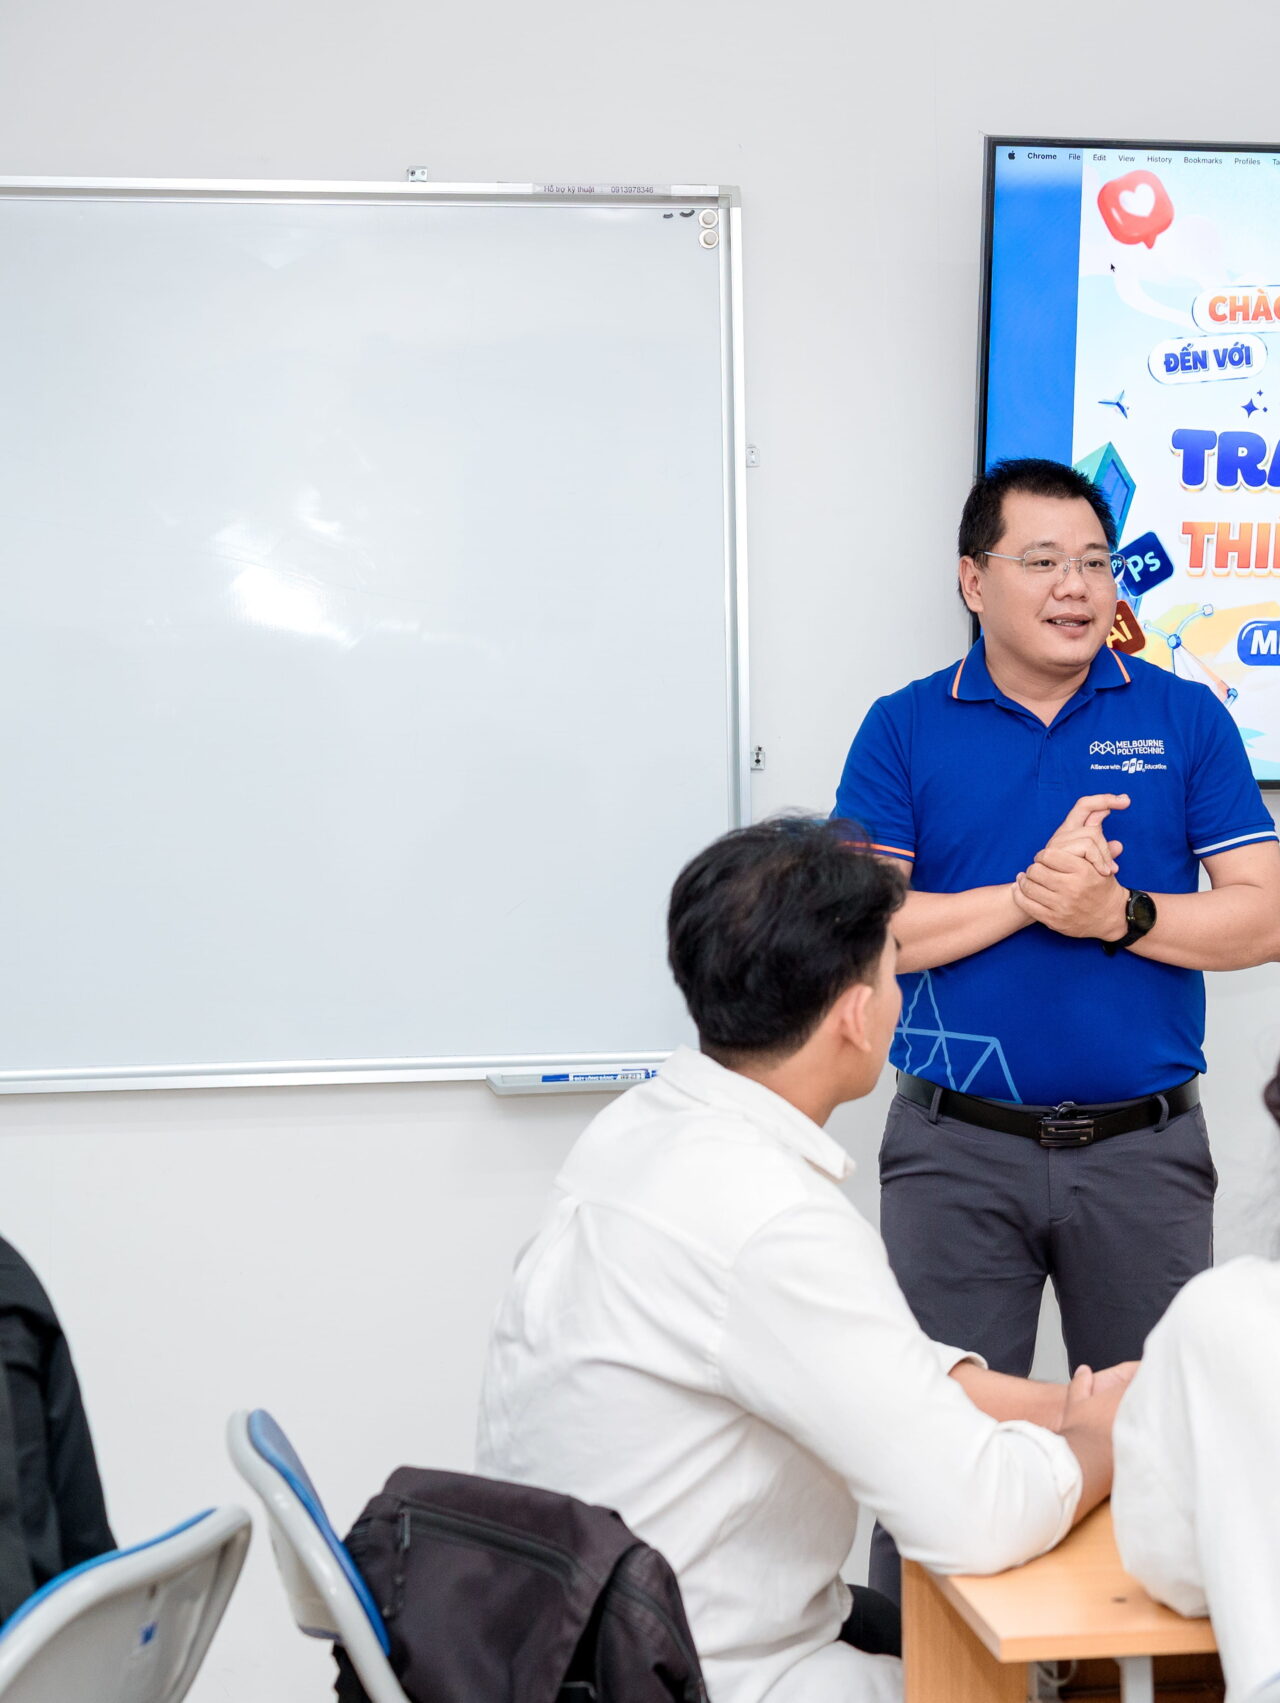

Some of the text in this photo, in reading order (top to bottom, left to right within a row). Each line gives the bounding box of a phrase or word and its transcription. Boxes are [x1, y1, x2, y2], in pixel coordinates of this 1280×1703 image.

[1028, 152, 1057, 160] Chrome
[1234, 158, 1260, 166] Profiles
[1164, 341, 1252, 374] ĐẾN VỚI
[1127, 551, 1161, 582] Ps
[1116, 740, 1164, 748] MELBOURNE
